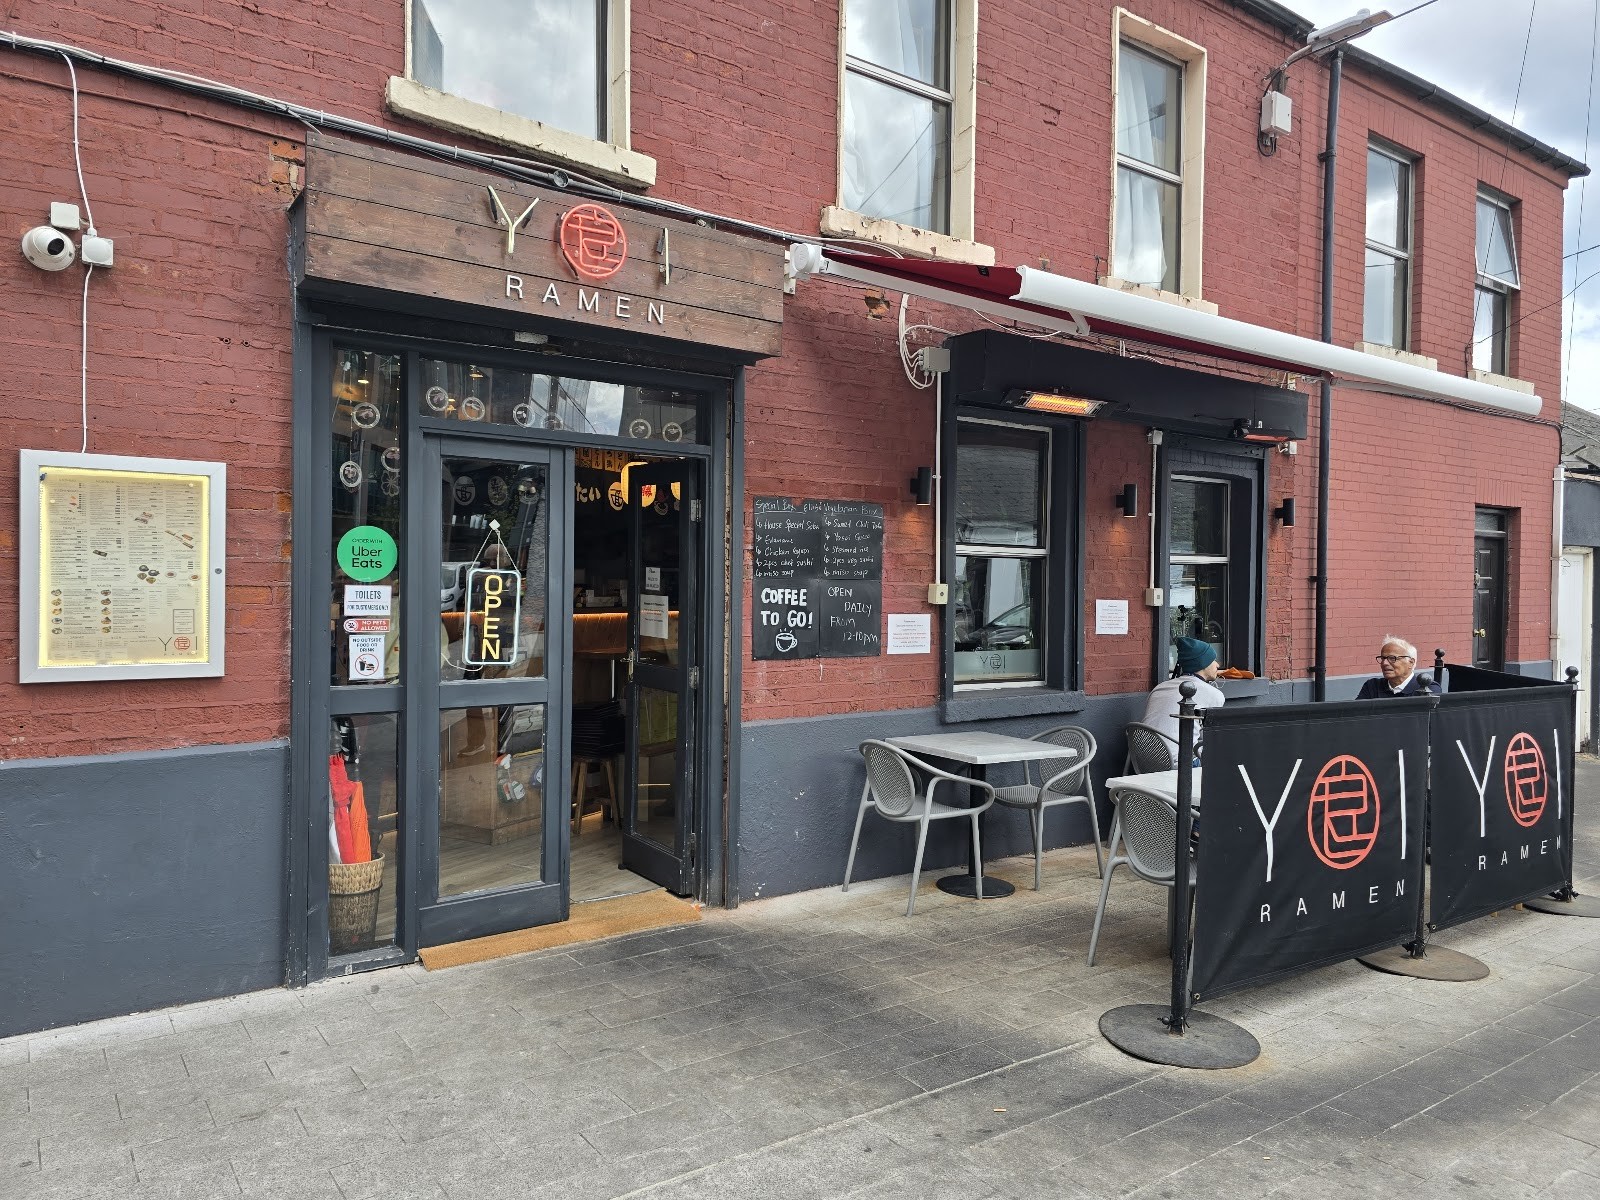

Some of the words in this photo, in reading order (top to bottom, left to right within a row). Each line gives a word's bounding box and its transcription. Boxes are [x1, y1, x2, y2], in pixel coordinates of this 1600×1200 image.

[506, 274, 664, 325] RAMEN
[764, 519, 783, 530] House
[784, 518, 805, 532] Special
[351, 545, 382, 557] Uber
[831, 545, 857, 554] Steamed
[351, 557, 382, 569] Eats
[762, 559, 778, 569] 2pcs
[796, 557, 814, 567] sushi
[832, 557, 845, 567] 2pcs
[847, 558, 858, 567] veg
[859, 555, 875, 564] sushi
[781, 569, 795, 578] soup
[853, 569, 869, 579] soup
[355, 590, 382, 600] TOILETS
[760, 587, 808, 607] COFFEE
[827, 586, 853, 597] OPEN
[844, 601, 872, 617] DAILY
[481, 574, 504, 660] OPEN
[760, 610, 780, 626] TO
[787, 609, 814, 629] GO!
[1260, 878, 1405, 923] RAMEN
